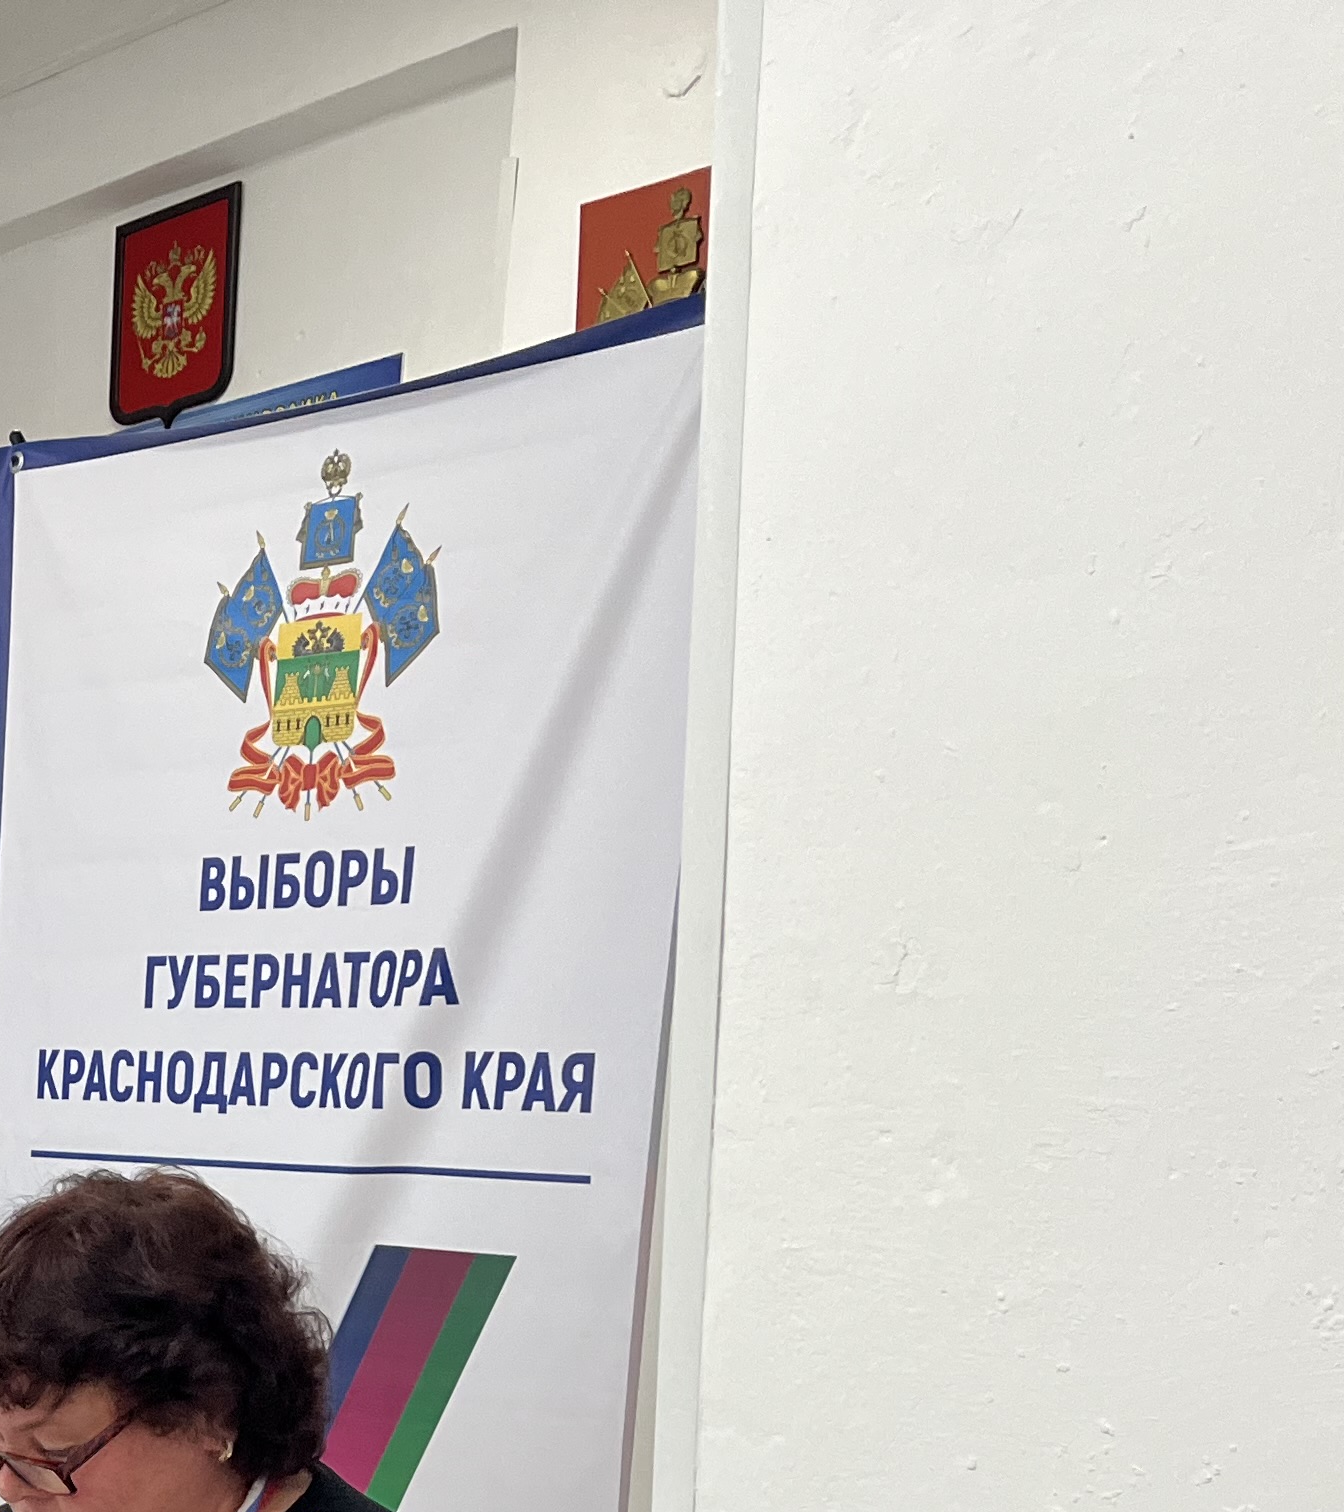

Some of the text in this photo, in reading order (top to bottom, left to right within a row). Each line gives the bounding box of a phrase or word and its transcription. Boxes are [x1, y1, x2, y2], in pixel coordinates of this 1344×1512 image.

[198, 845, 417, 912] ВЫБОРЫ
[142, 946, 461, 1011] ГУБЕРНАТОРА
[36, 1048, 596, 1114] КРАСНОДАРСКОГО КРАЯ
